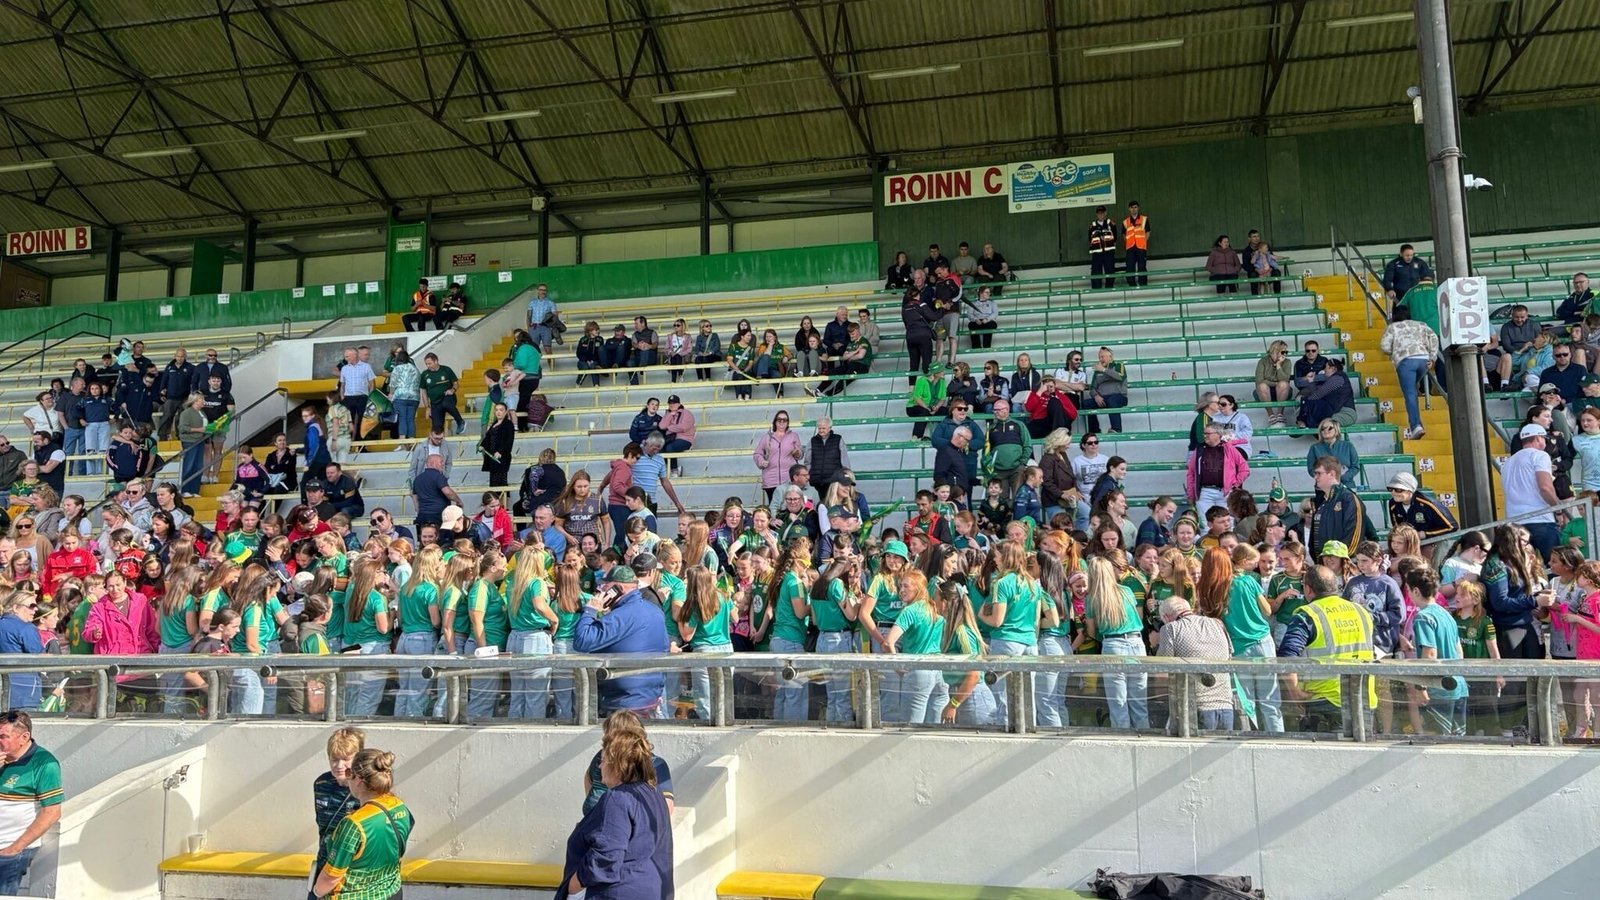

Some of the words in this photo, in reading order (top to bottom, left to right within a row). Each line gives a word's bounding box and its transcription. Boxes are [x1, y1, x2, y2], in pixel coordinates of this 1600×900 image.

[1043, 162, 1077, 182] free
[890, 170, 972, 203] ROINN
[984, 167, 1003, 194] C
[10, 230, 67, 255] ROINN
[76, 228, 88, 250] B
[1456, 279, 1479, 296] C
[1459, 311, 1482, 329] D
[1325, 606, 1339, 614] An
[1333, 618, 1358, 628] Maor
